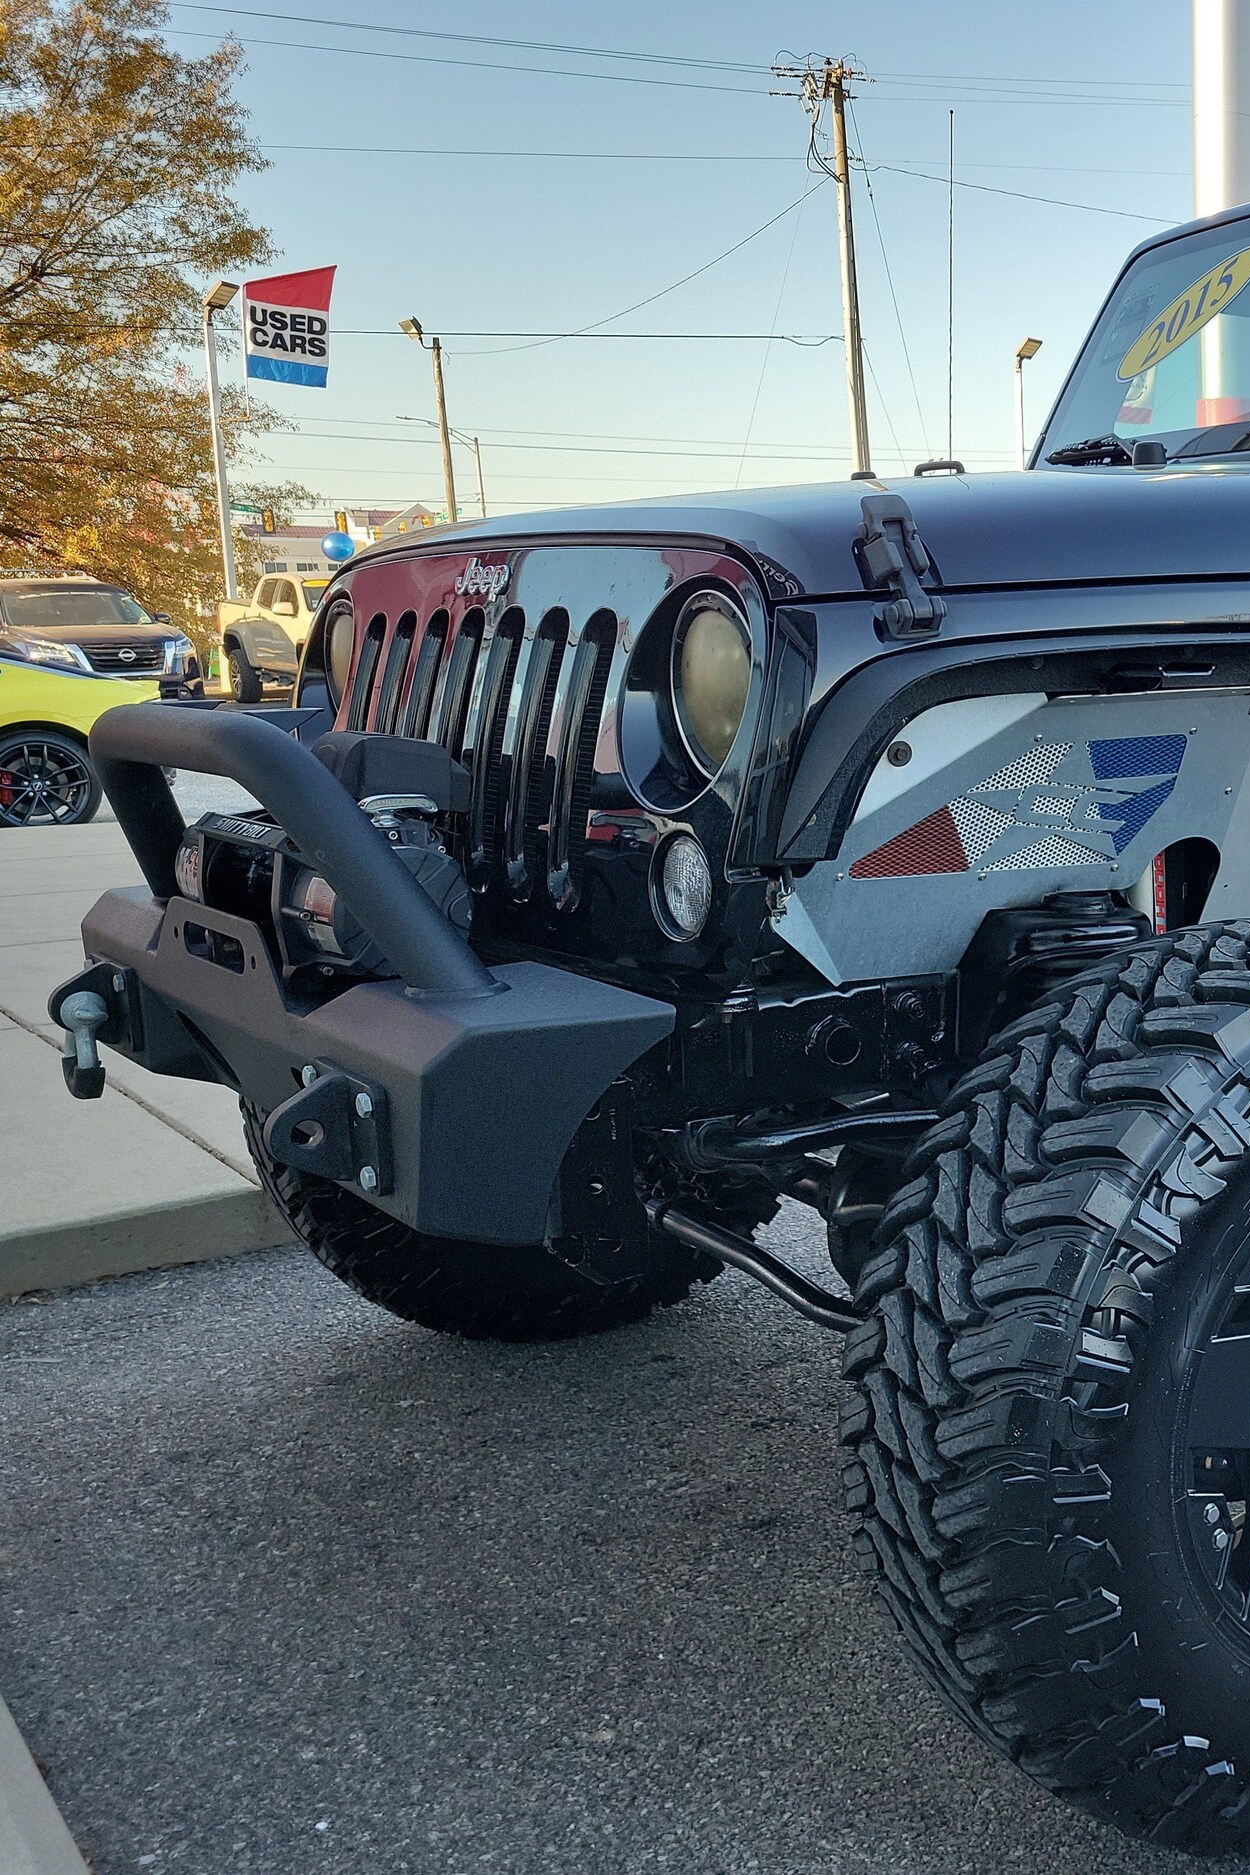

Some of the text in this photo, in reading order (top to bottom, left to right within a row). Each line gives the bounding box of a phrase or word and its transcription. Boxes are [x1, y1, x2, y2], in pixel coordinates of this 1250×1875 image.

[250, 305, 327, 336] USED
[1140, 256, 1240, 368] 2015
[250, 327, 327, 357] CARS
[454, 557, 511, 602] Jeep
[1154, 850, 1165, 918] OUGH
